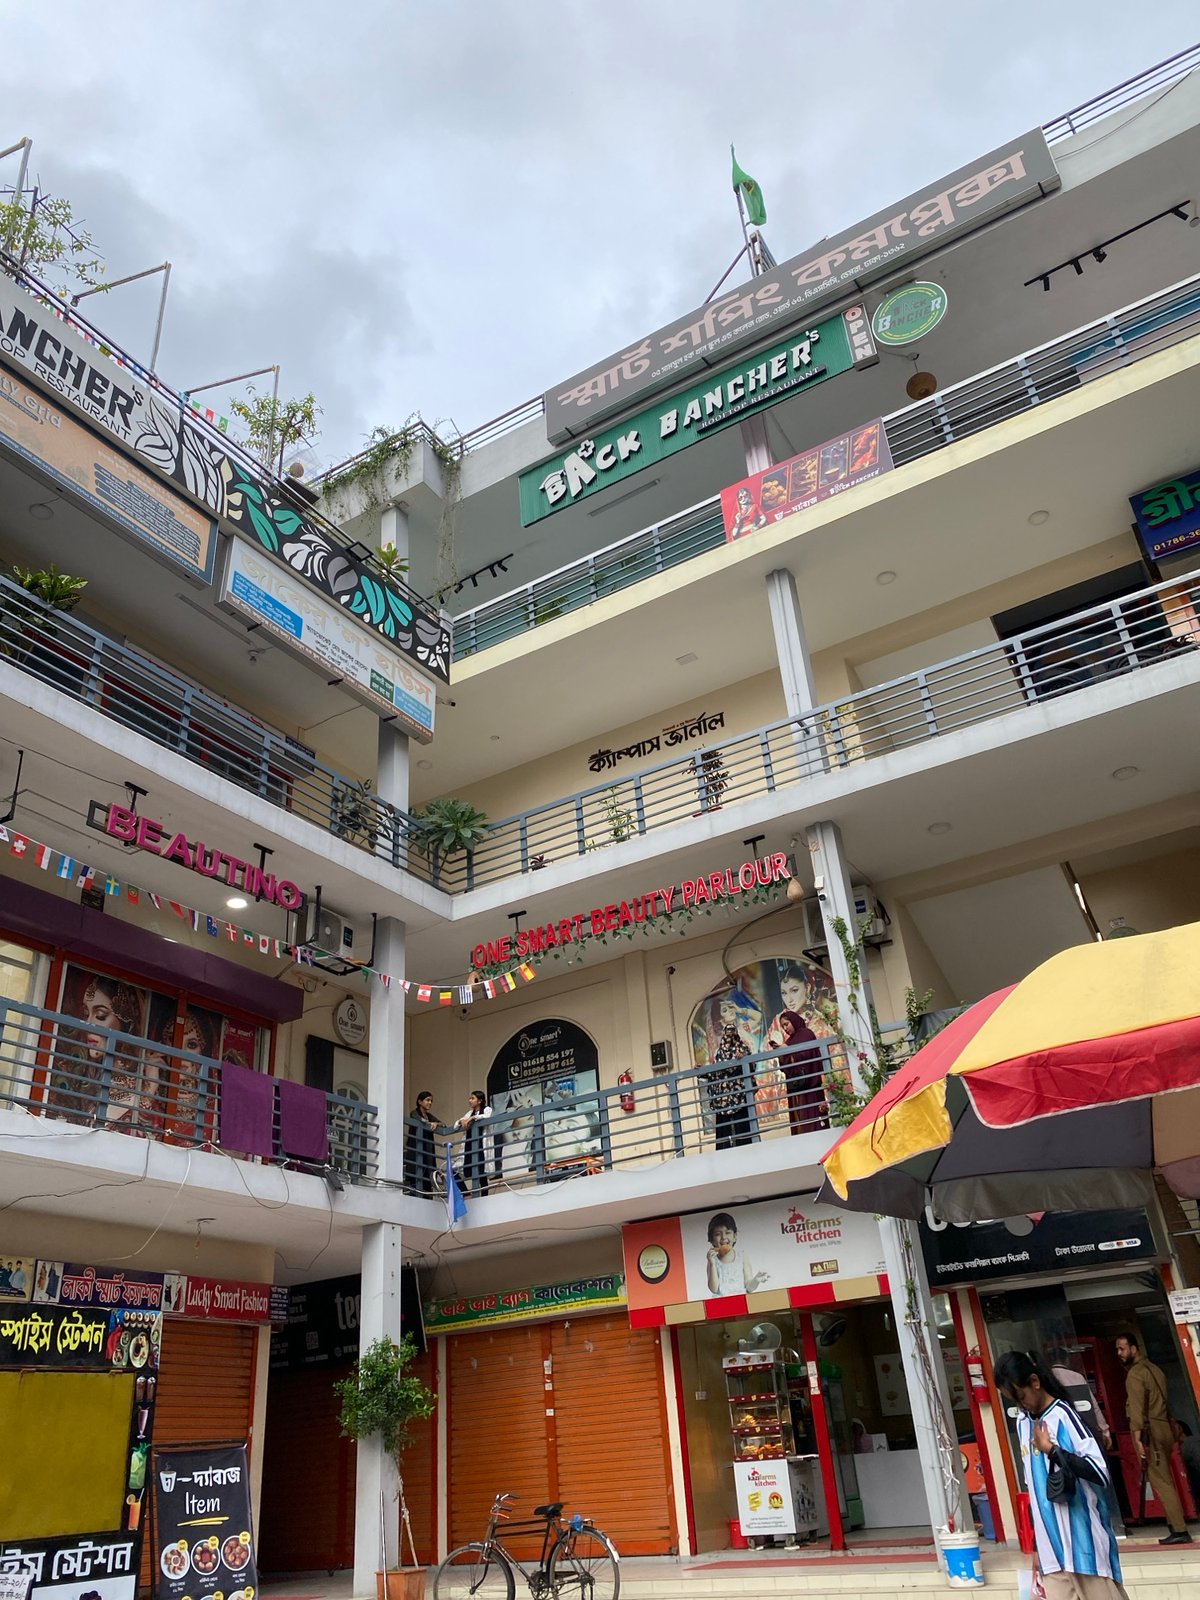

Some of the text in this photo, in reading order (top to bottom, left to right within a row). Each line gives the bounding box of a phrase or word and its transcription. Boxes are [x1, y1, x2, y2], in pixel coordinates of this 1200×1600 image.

[660, 282, 784, 354] শপিং
[791, 151, 1027, 287] কমপ্লেক্স
[845, 306, 872, 360] OPEN
[34, 362, 132, 440] RESTAURANT
[701, 366, 821, 429] ROOFTOP RESTAURANT
[539, 430, 642, 506] BACK
[587, 735, 660, 773] ক্যাম্পাস
[662, 711, 725, 747] জার্নাল
[106, 801, 303, 910] BEAUTINO
[471, 851, 792, 969] ONE SMART BEAUTY PARLOUR
[522, 1048, 575, 1069] 01618 554 197
[795, 1228, 842, 1244] kitchen
[1125, 1239, 1138, 1247] VISA
[62, 1266, 97, 1302] লাকী
[122, 1281, 163, 1307] ফ্যাশন
[186, 1280, 213, 1315] Lucky
[213, 1284, 241, 1312] Smart
[240, 1288, 269, 1315] Fashion
[533, 1277, 614, 1301] কালেকশন
[0, 1310, 106, 1355] স্পাইস স্টেশন
[185, 1491, 221, 1515] Item
[51, 1541, 134, 1580] স্টেশন
